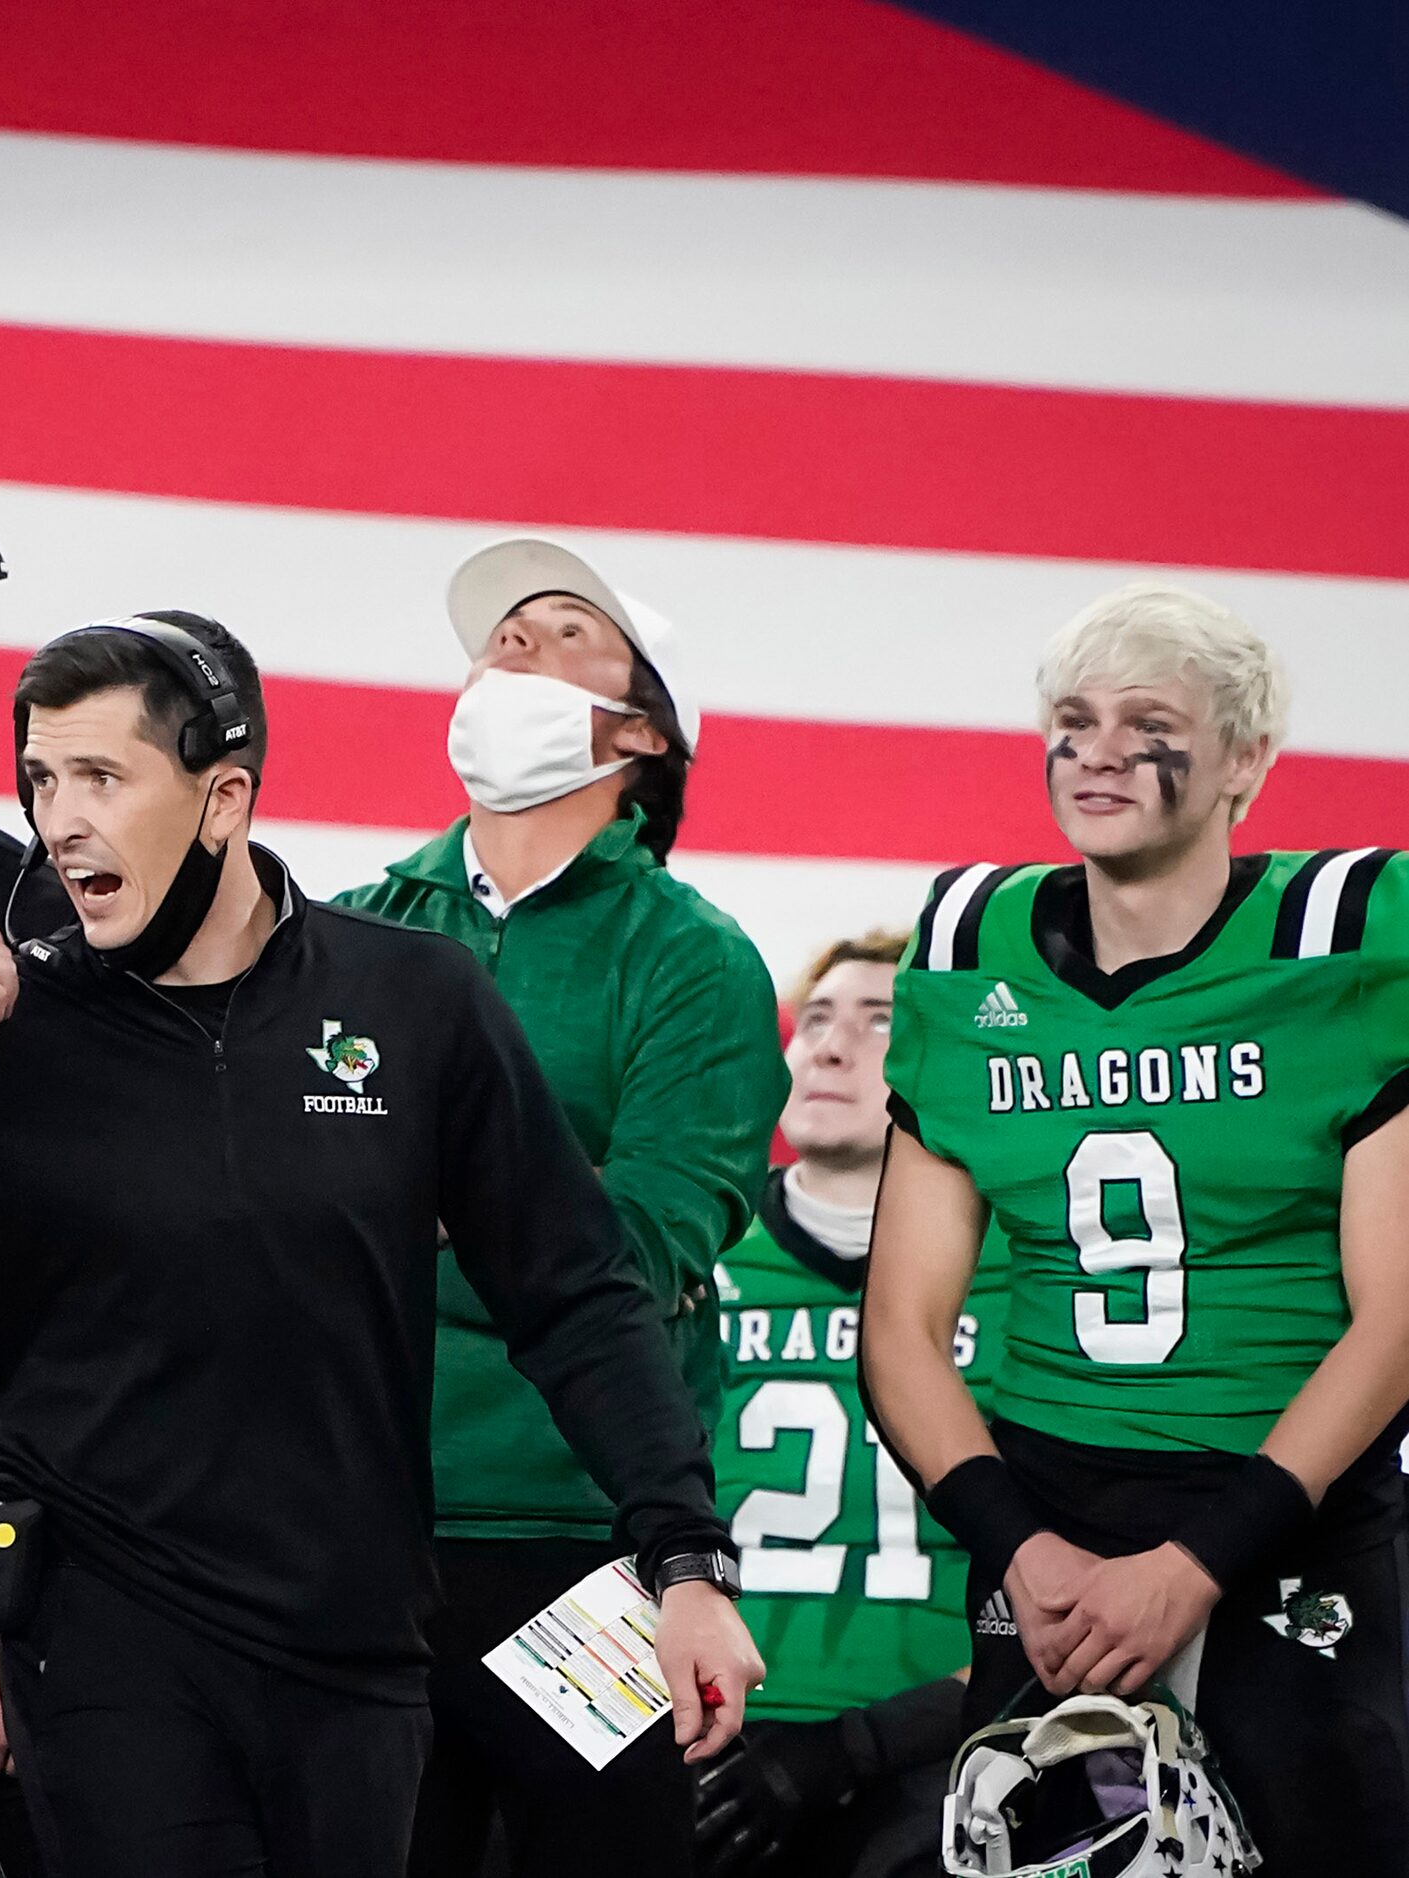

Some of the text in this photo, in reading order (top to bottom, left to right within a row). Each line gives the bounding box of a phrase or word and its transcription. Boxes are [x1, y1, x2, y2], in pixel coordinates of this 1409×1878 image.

[225, 723, 248, 742] AT&T
[303, 1094, 389, 1116] FOOTBALL
[987, 1041, 1265, 1113] DRAGONS
[1065, 1131, 1186, 1365] 9
[730, 1379, 932, 1601] 21
